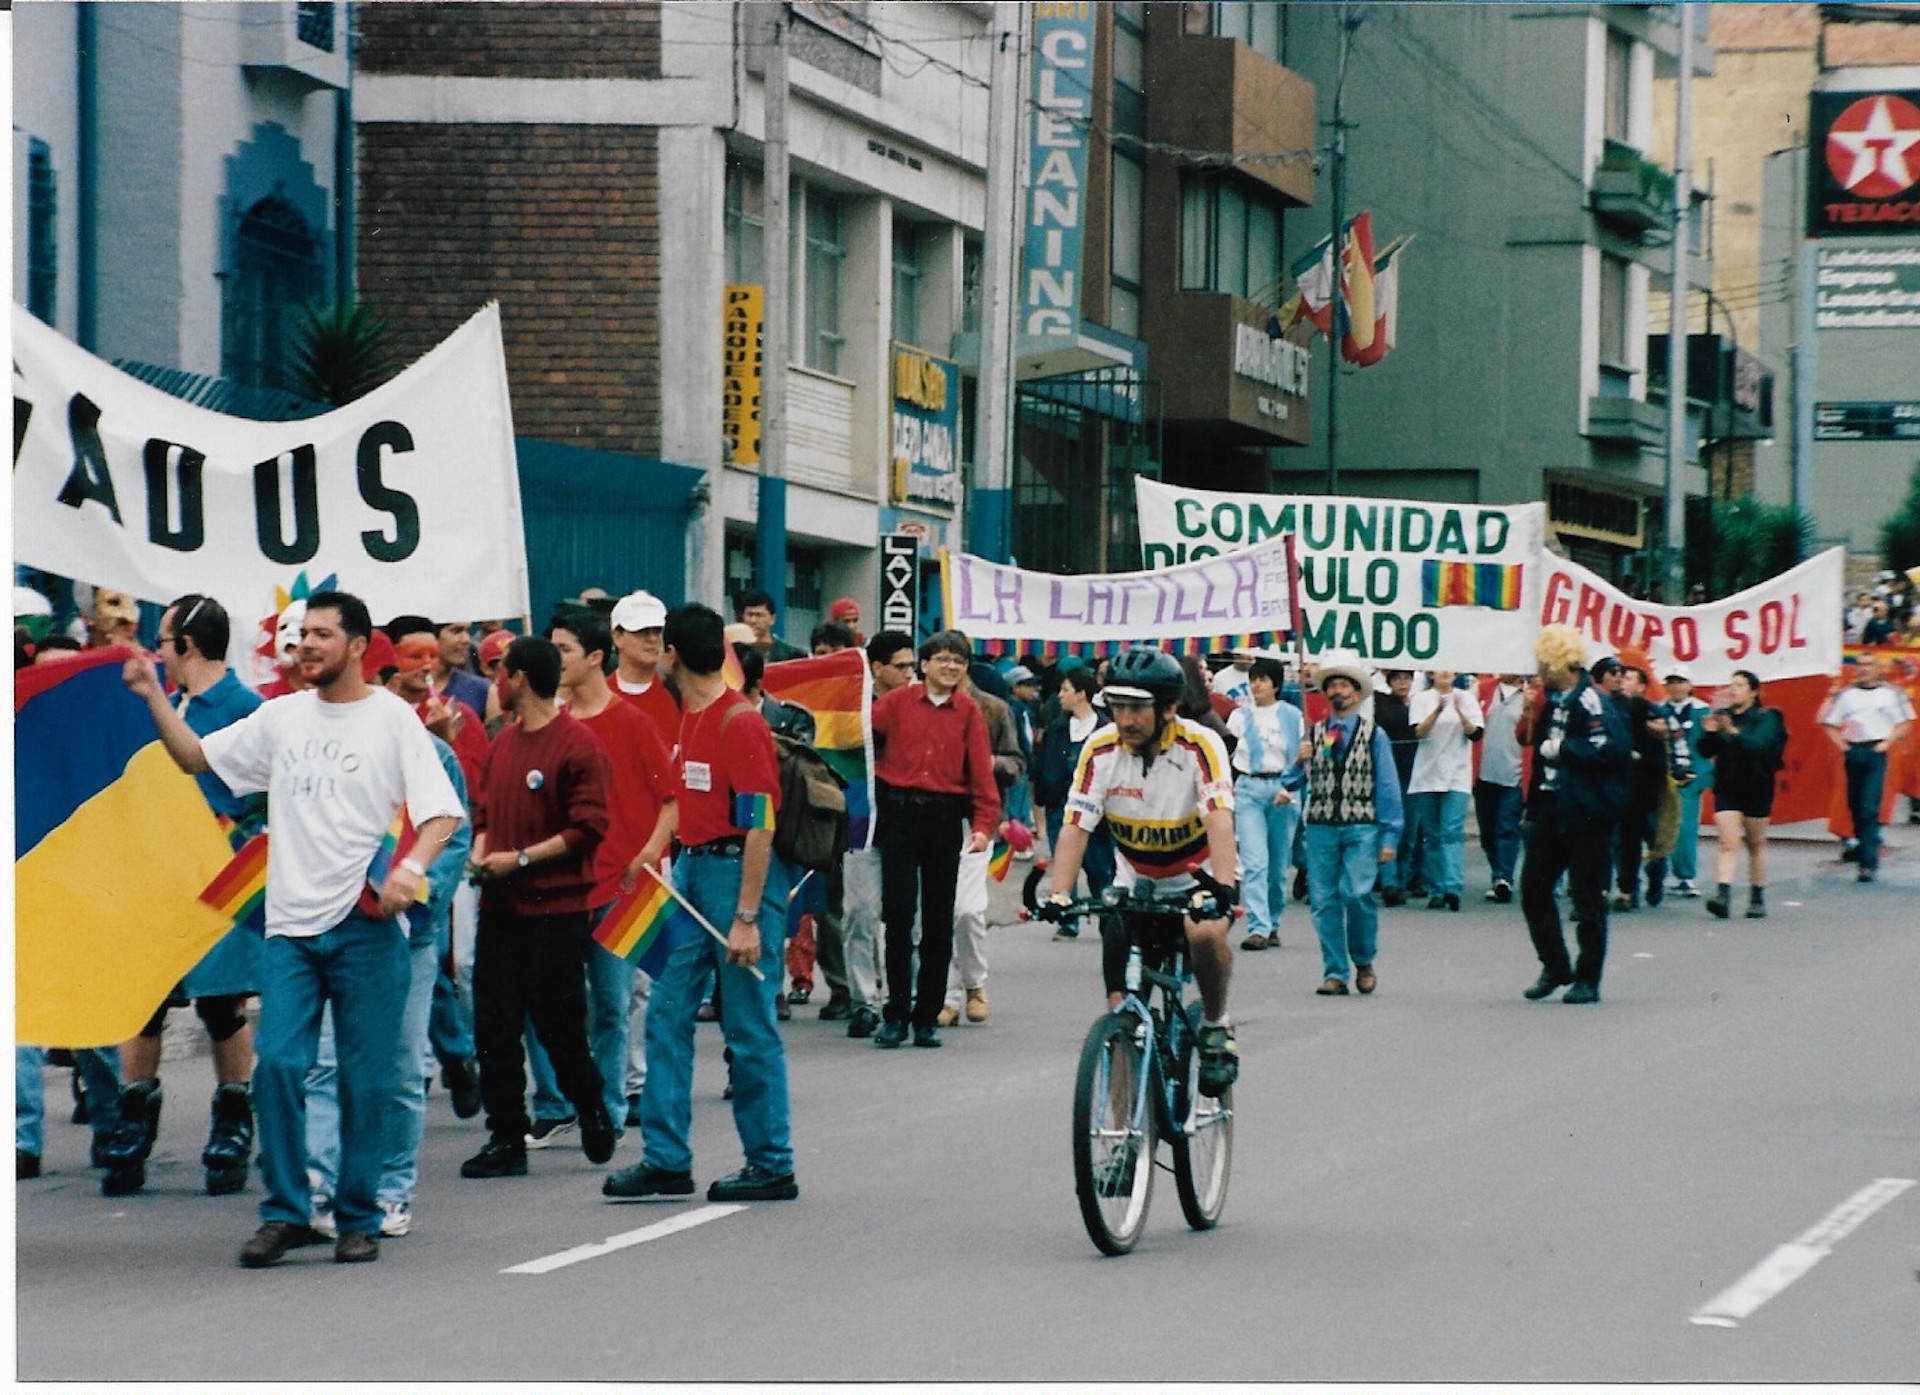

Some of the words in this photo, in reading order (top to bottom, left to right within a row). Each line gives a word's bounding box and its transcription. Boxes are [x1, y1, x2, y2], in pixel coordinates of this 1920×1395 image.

[1028, 29, 1086, 336] CLEANING
[1175, 498, 1510, 555] COMUNIDAD
[1541, 571, 1699, 661] GRUPO
[1725, 593, 1807, 660] SOL
